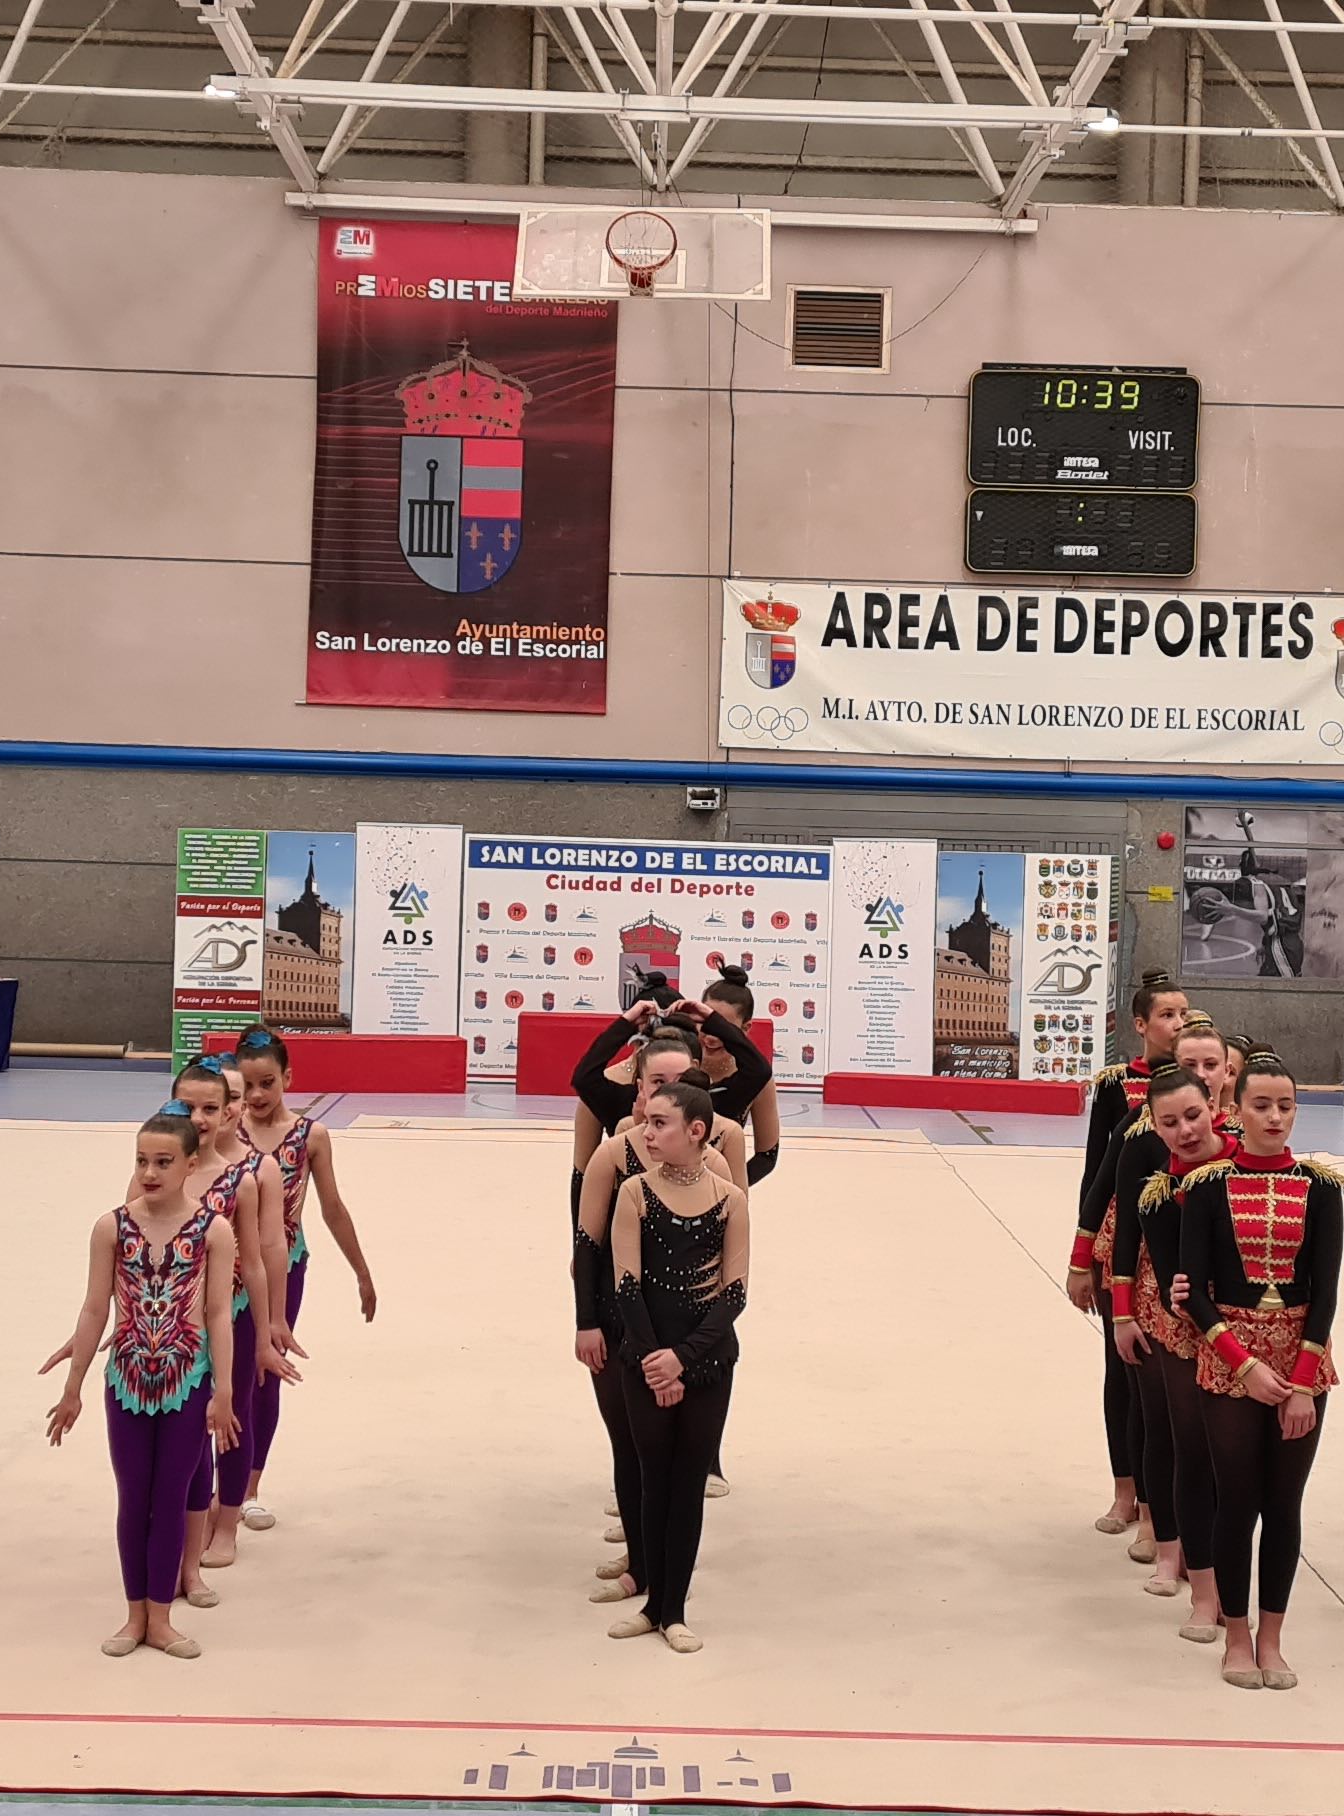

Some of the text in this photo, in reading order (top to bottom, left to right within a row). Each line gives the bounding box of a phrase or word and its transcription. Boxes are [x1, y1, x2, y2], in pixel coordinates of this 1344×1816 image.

[428, 278, 510, 302] SIETE
[485, 304, 608, 319] del Deporte Madrileño
[1042, 379, 1141, 410] 10:39
[997, 426, 1037, 447] LOC.
[1128, 430, 1174, 451] VISIT.
[456, 619, 605, 642] Ayuntamiento
[820, 591, 1314, 660] AREA DE DEPORTES
[315, 630, 605, 659] San Lorenzo de El Escorial
[821, 697, 1305, 731] M.I. AYTO. DE SAN LORENZO DE EL ESCORIAL
[480, 845, 823, 875] SAN LORENZO DE EL ESCORIAL
[546, 873, 755, 898] Ciudad del Deporte
[383, 929, 434, 946] ADS
[859, 943, 909, 960] ADS
